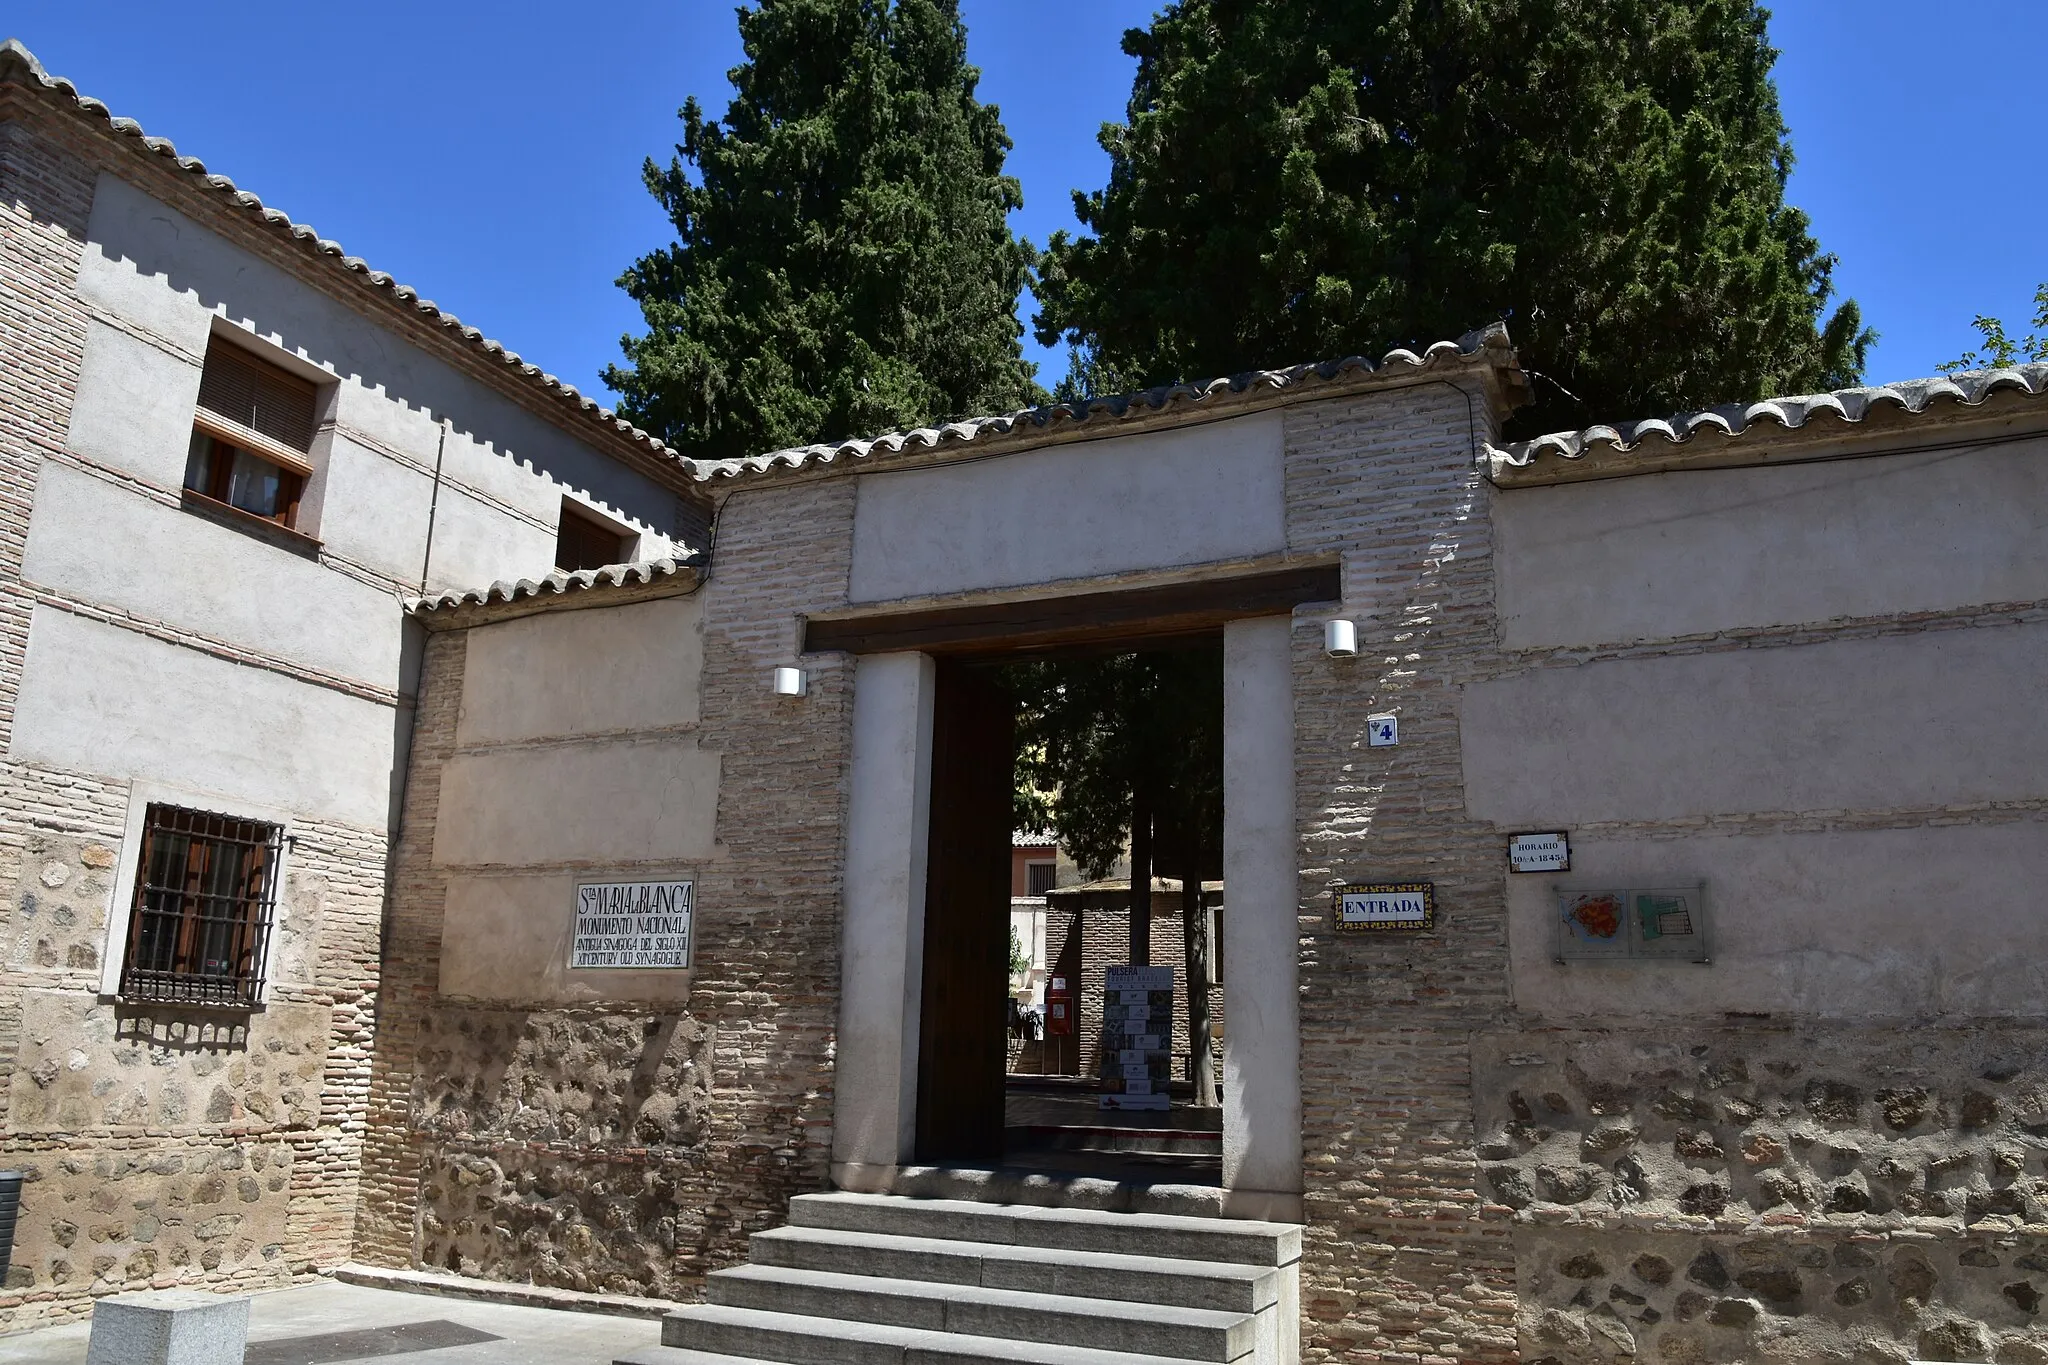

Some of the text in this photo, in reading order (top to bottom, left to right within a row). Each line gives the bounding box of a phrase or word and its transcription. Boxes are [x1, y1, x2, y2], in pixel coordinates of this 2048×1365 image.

[1379, 724, 1393, 741] 4
[1518, 842, 1558, 852] HORARIO
[594, 886, 633, 915] MARIA
[631, 900, 640, 914] LA
[639, 884, 692, 914] BLANCA
[1345, 899, 1422, 914] ENTRADA
[577, 916, 687, 936] MONUMENTO NACIONAL
[575, 938, 602, 951] ANTIGUA
[603, 937, 638, 951] SINAGOGA
[640, 937, 653, 951] DEL
[655, 936, 676, 951] SIGLO
[620, 951, 634, 965] OLD
[1107, 966, 1138, 976] PULSERA
